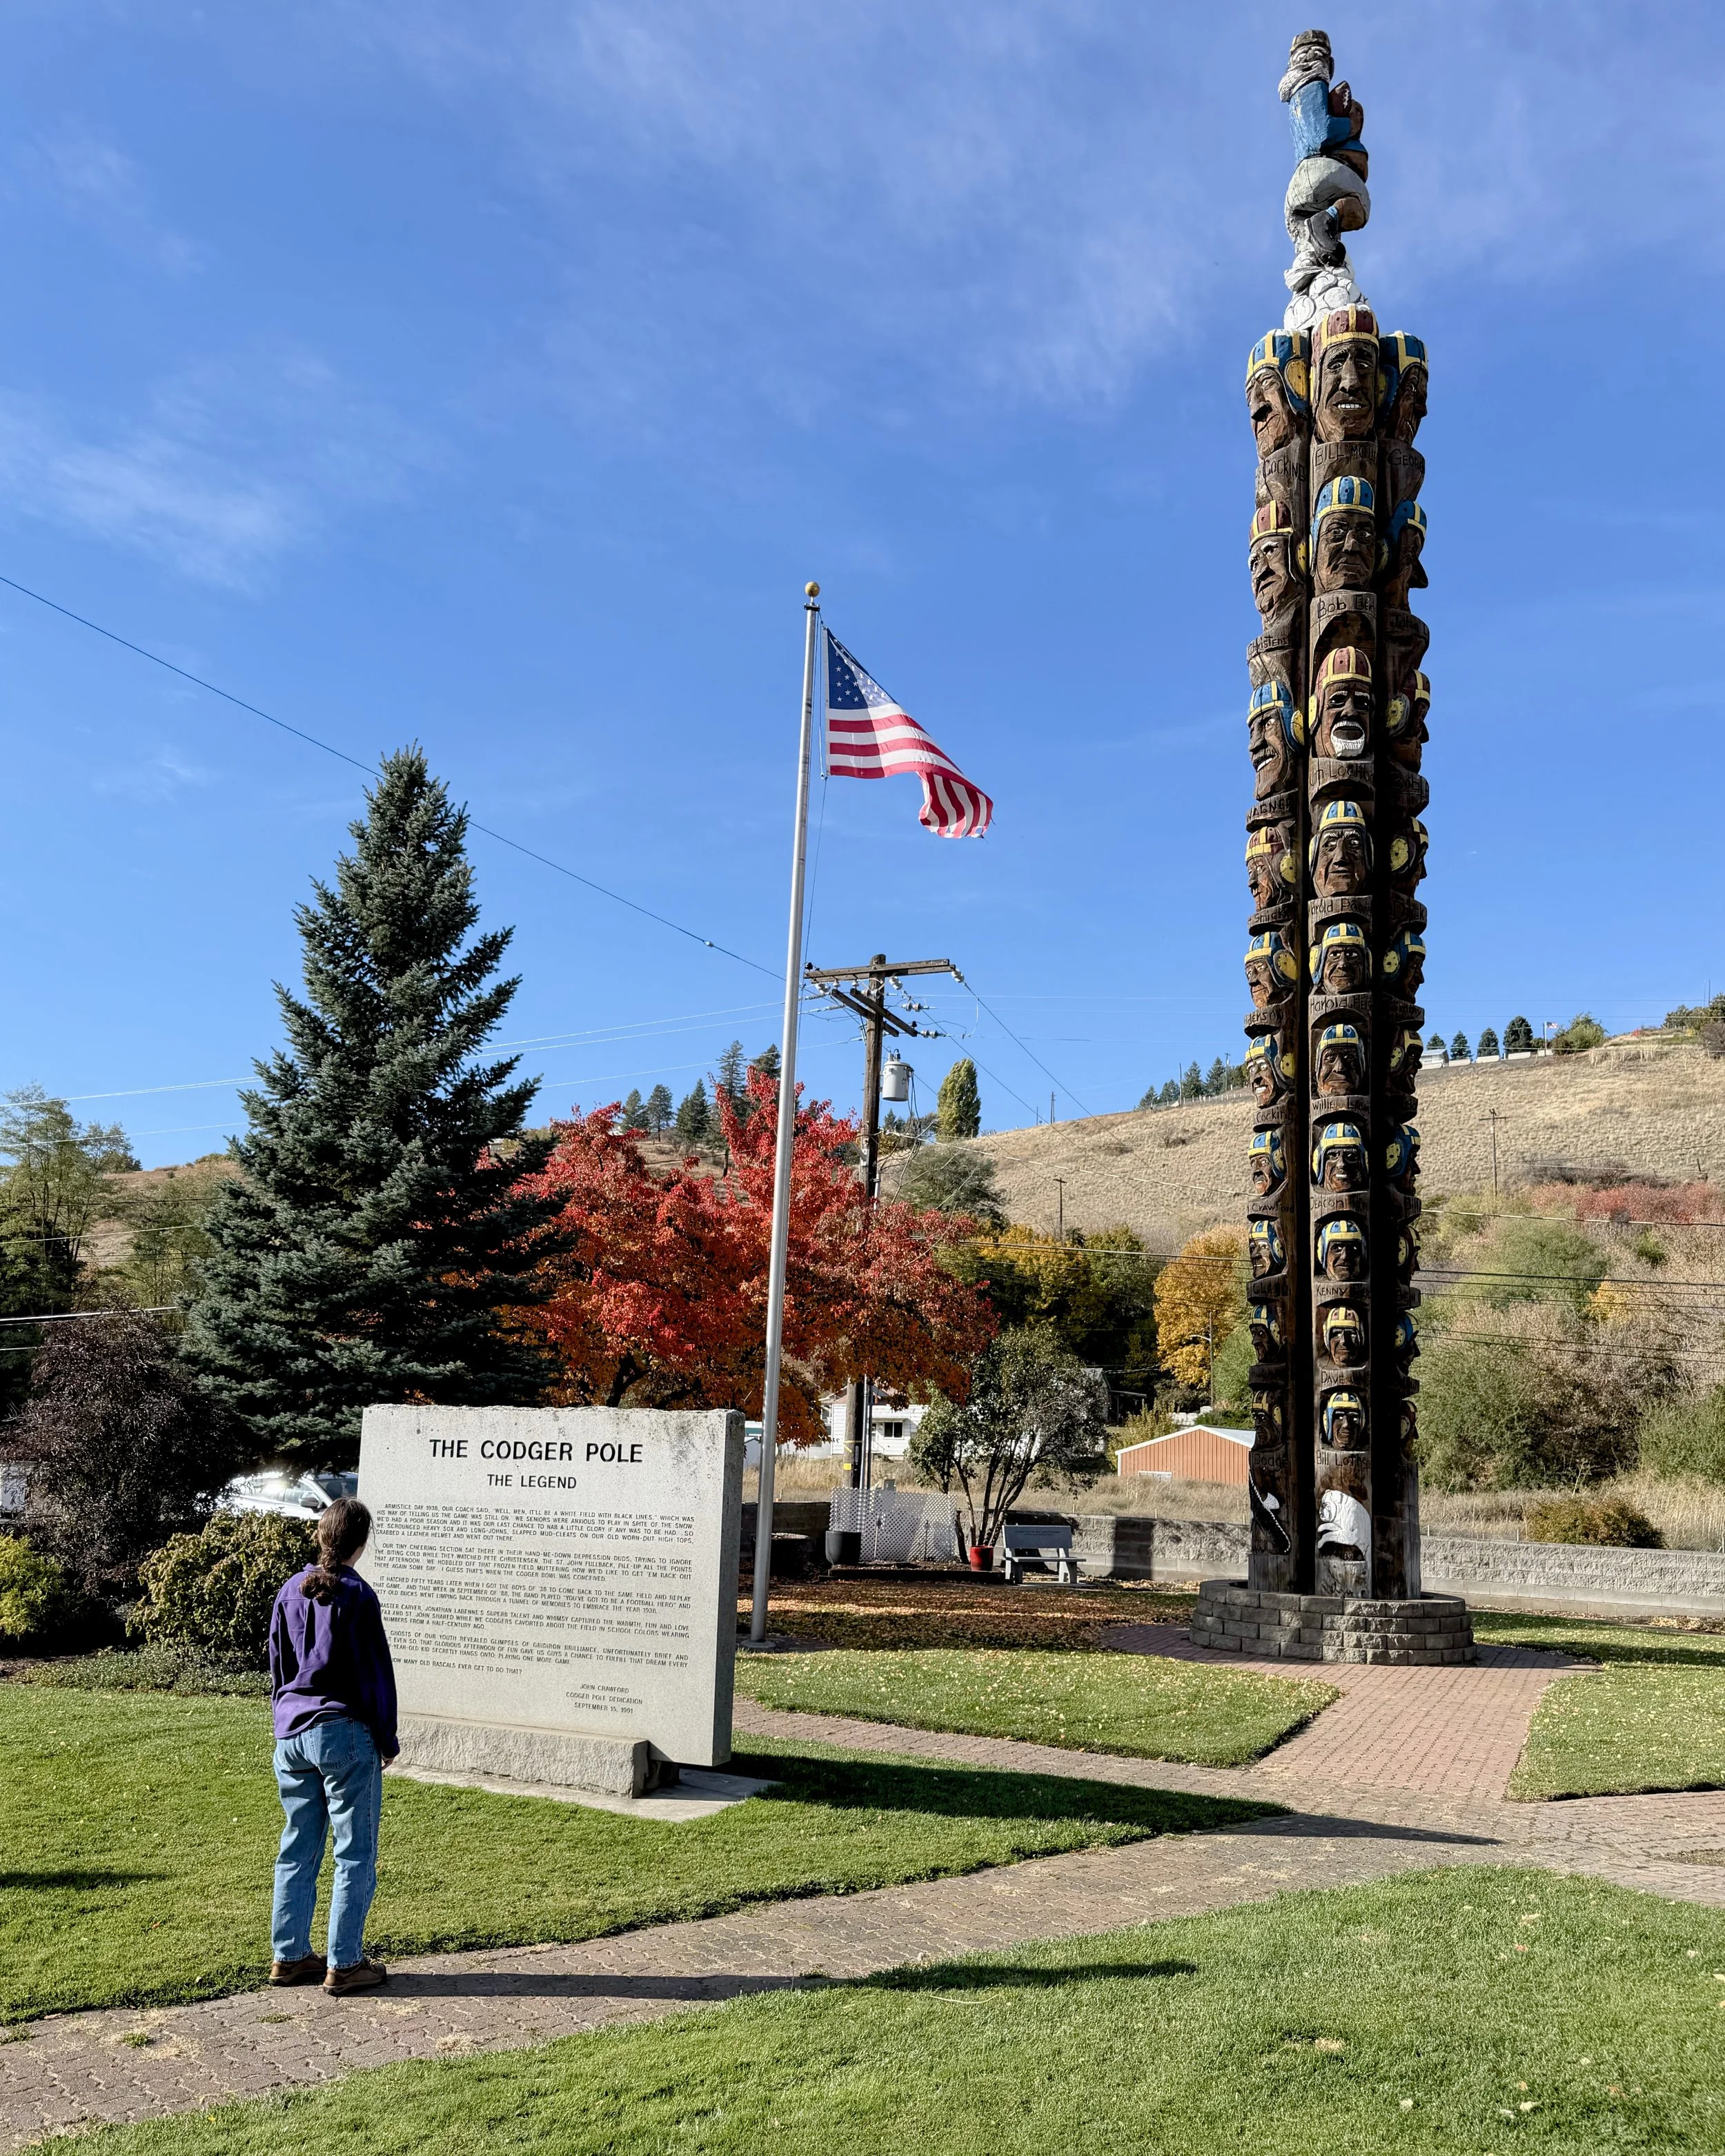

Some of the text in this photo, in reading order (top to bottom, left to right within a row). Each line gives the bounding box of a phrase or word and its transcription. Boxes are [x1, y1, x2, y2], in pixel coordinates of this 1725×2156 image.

[1315, 445, 1345, 467] BILL
[1318, 597, 1347, 618] Bob
[1317, 1285, 1348, 1296] KENNY
[1321, 1371, 1344, 1384] DAVE
[429, 1439, 644, 1463] THE CODGER POLE
[1317, 1450, 1329, 1465] Bill
[487, 1474, 578, 1490] THE LEGEND
[463, 1643, 495, 1651] AFTERNOON
[602, 1648, 651, 1657] UNFORTUNATELY
[598, 1685, 629, 1694] CRAWFORD
[566, 1691, 590, 1699] CODGER
[609, 1696, 643, 1705] DEDICATION
[574, 1701, 608, 1711] SEPTEMBER
